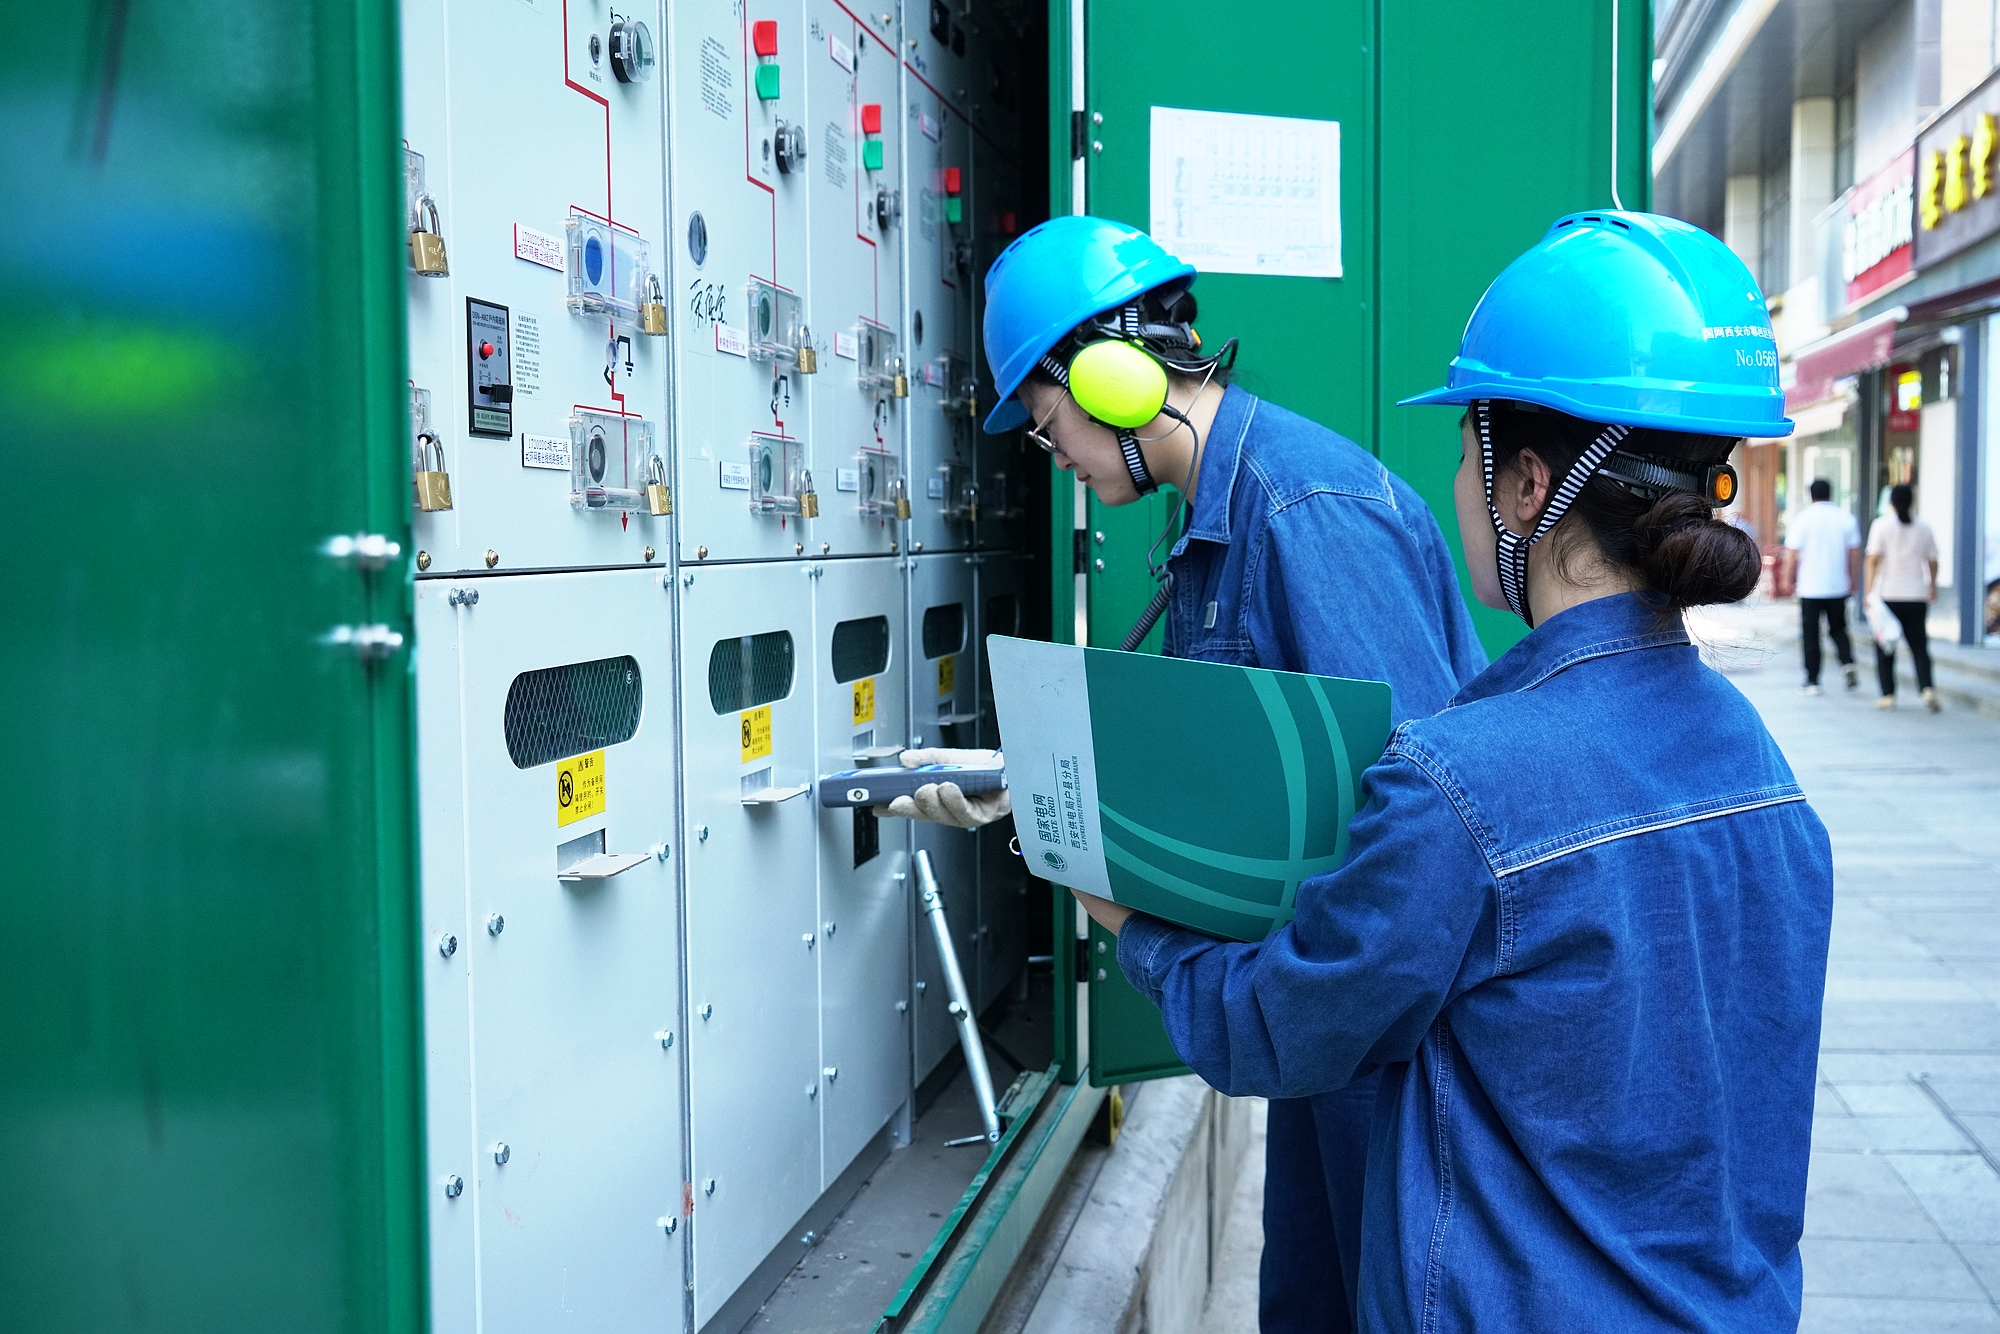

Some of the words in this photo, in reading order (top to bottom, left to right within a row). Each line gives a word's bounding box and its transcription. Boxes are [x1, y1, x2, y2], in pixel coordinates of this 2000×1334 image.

[1033, 793, 1053, 843] 国家电网
[1047, 796, 1056, 818] GRID
[1060, 759, 1081, 849] 西安供电局户县分局
[1050, 819, 1061, 845] STATE
